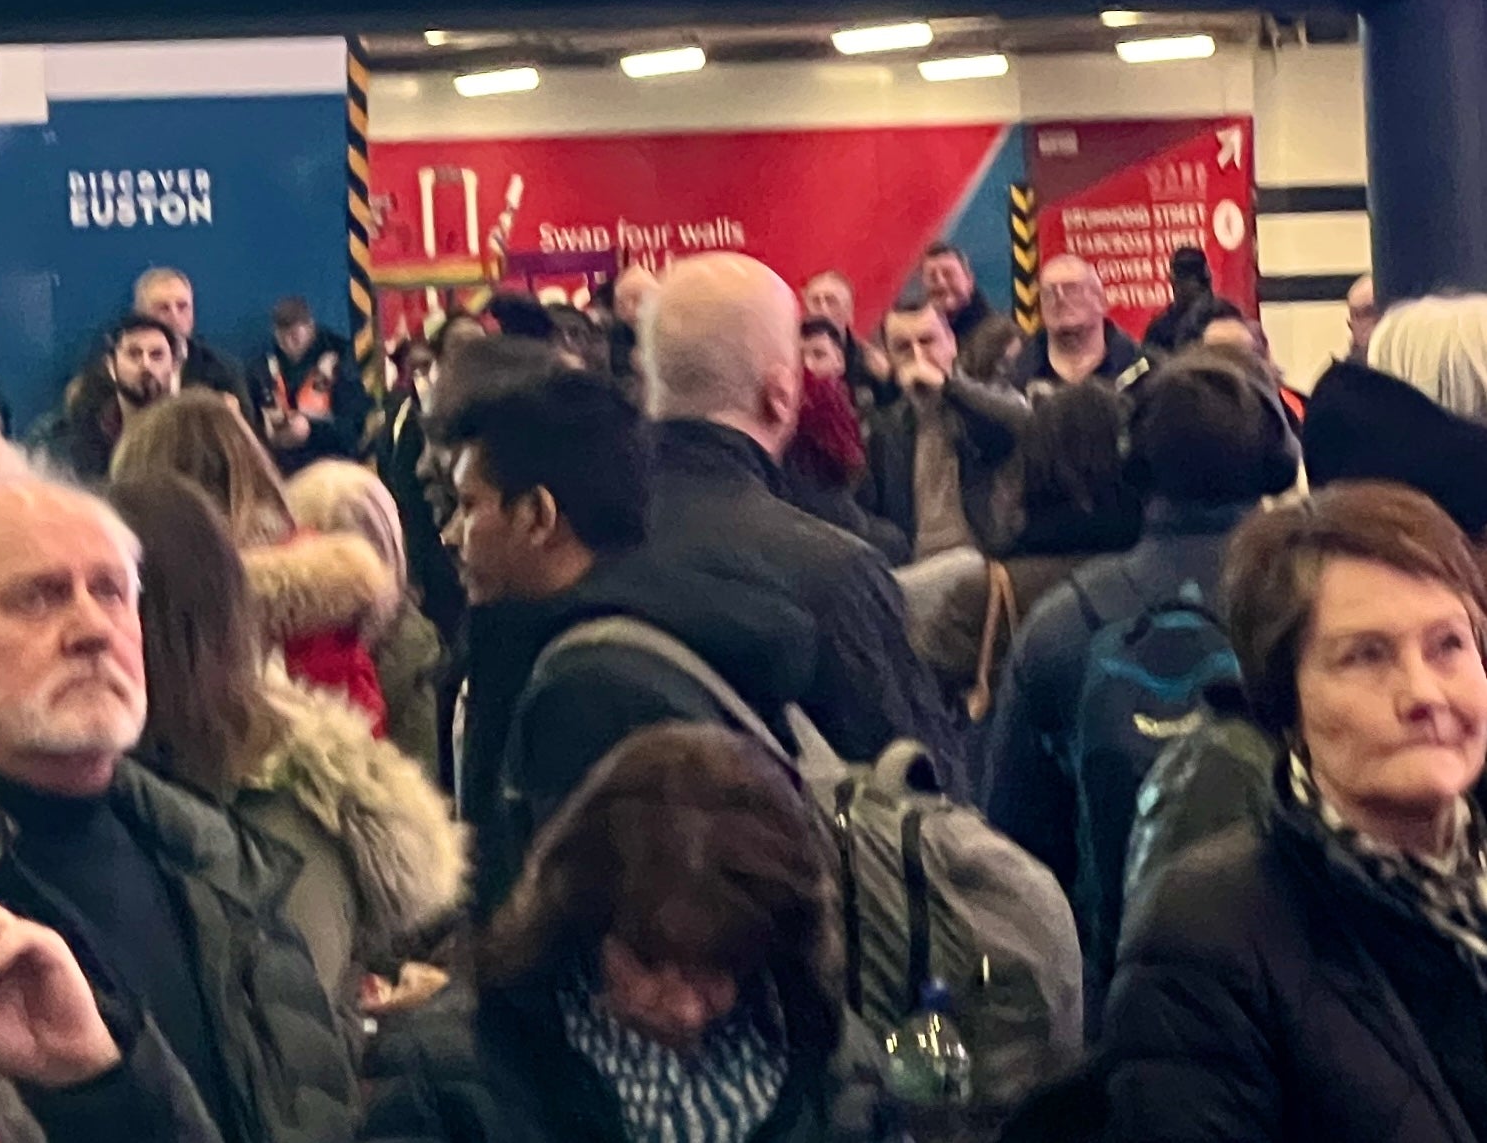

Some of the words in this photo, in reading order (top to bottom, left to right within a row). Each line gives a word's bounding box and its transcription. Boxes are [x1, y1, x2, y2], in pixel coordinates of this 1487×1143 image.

[68, 168, 211, 196] DISCOVER
[69, 192, 213, 228] EUSTON
[539, 221, 611, 254] Swap
[617, 216, 672, 251] four
[677, 215, 746, 249] walls
